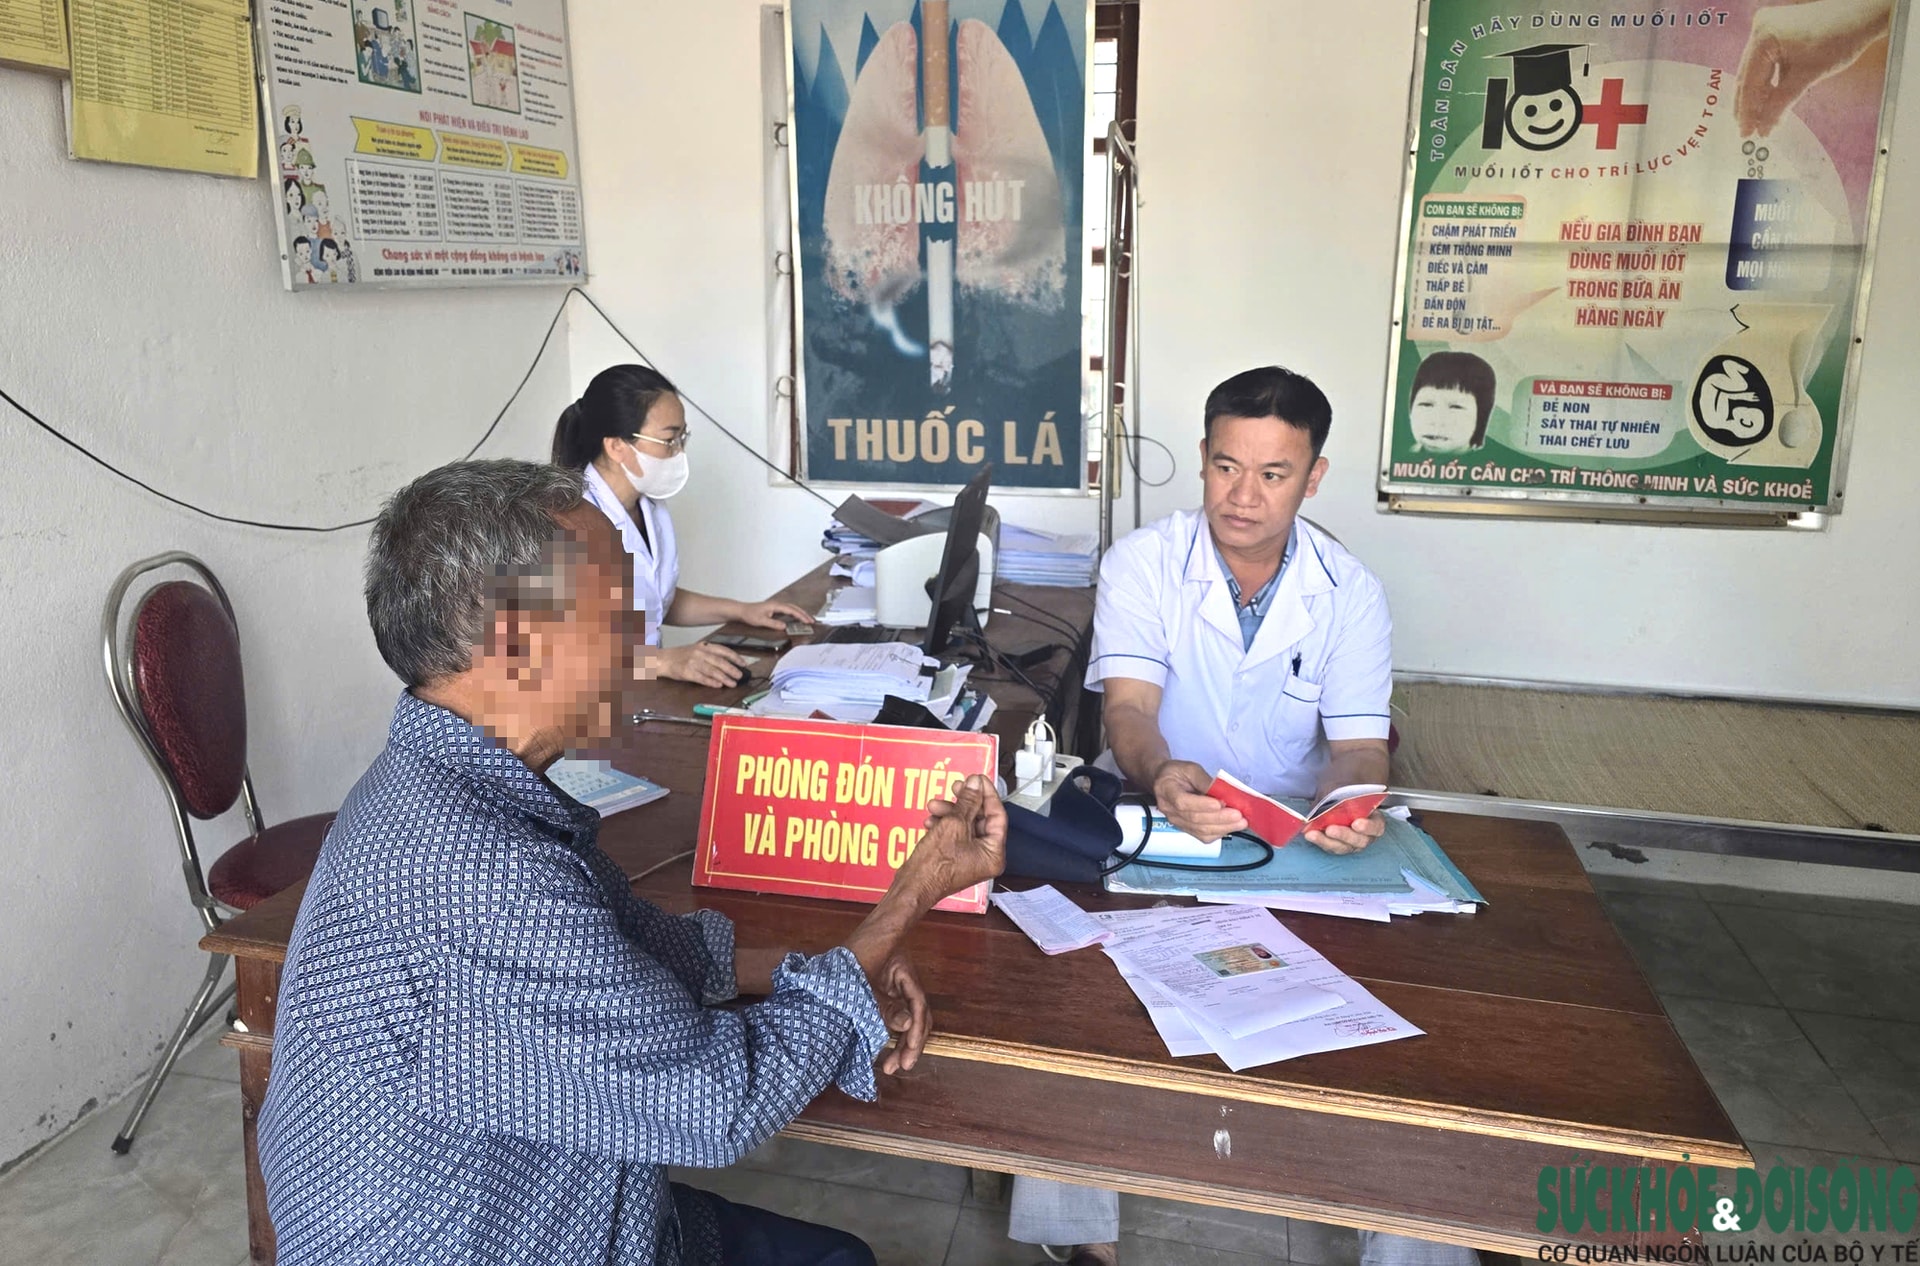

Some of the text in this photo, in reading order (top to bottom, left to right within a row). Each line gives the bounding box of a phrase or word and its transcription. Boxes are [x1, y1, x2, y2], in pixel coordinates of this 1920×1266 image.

[1430, 6, 1729, 161] TOÀN DÂN HÃY DÙNG MUỐI IỐT
[1455, 69, 1722, 179] MUỐI IỐT CHO TRÍ LỰC VẸN TOÀN
[855, 171, 1026, 225] KHÔNG HÚT
[1426, 204, 1445, 215] CON
[1446, 204, 1462, 217] BẠN
[1466, 202, 1477, 215] SẼ
[1479, 203, 1510, 216] KHÔNG
[1432, 222, 1517, 239] CHẬM PHÁT TRIỂN
[1561, 216, 1702, 246] NẾU GIA ĐÌNH BẠN
[1429, 242, 1512, 257] KÉM THÔNG MINH
[1569, 246, 1686, 271] DÙNG MUỐI IỐT
[1427, 258, 1488, 275] ĐIẾC VÀ CÂM
[1736, 260, 1764, 282] MỌI
[1426, 276, 1464, 293] THẤP BÉ
[1568, 277, 1681, 299] TRONG BỮA ĂN
[1437, 317, 1449, 329] RA
[1576, 304, 1665, 327] HÀNG NGÀY
[1540, 381, 1667, 401] VÀ BẠN SẼ KHÔNG BỊ:
[1562, 402, 1590, 413] NON
[827, 405, 1064, 465] THUỐC LÁ
[1570, 419, 1597, 431] THAI
[1601, 420, 1618, 434] TỰ
[1620, 420, 1660, 434] NHIÊN
[1540, 433, 1630, 449] THAI CHẾT LƯU
[1393, 458, 1436, 478] MUỐI
[1440, 459, 1468, 480] IỐT
[1471, 462, 1506, 482] CẦN
[1550, 466, 1577, 485] TRÍ
[1582, 469, 1639, 489] THÔNG
[1643, 474, 1688, 492] MINH
[1693, 474, 1718, 494] VÀ
[1723, 476, 1759, 497] SỨC
[1764, 479, 1813, 500] KHOẺ
[736, 747, 829, 802] PHÒNG
[835, 755, 895, 808] ĐÓN
[744, 805, 928, 870] VÀ PHÒNG CH
